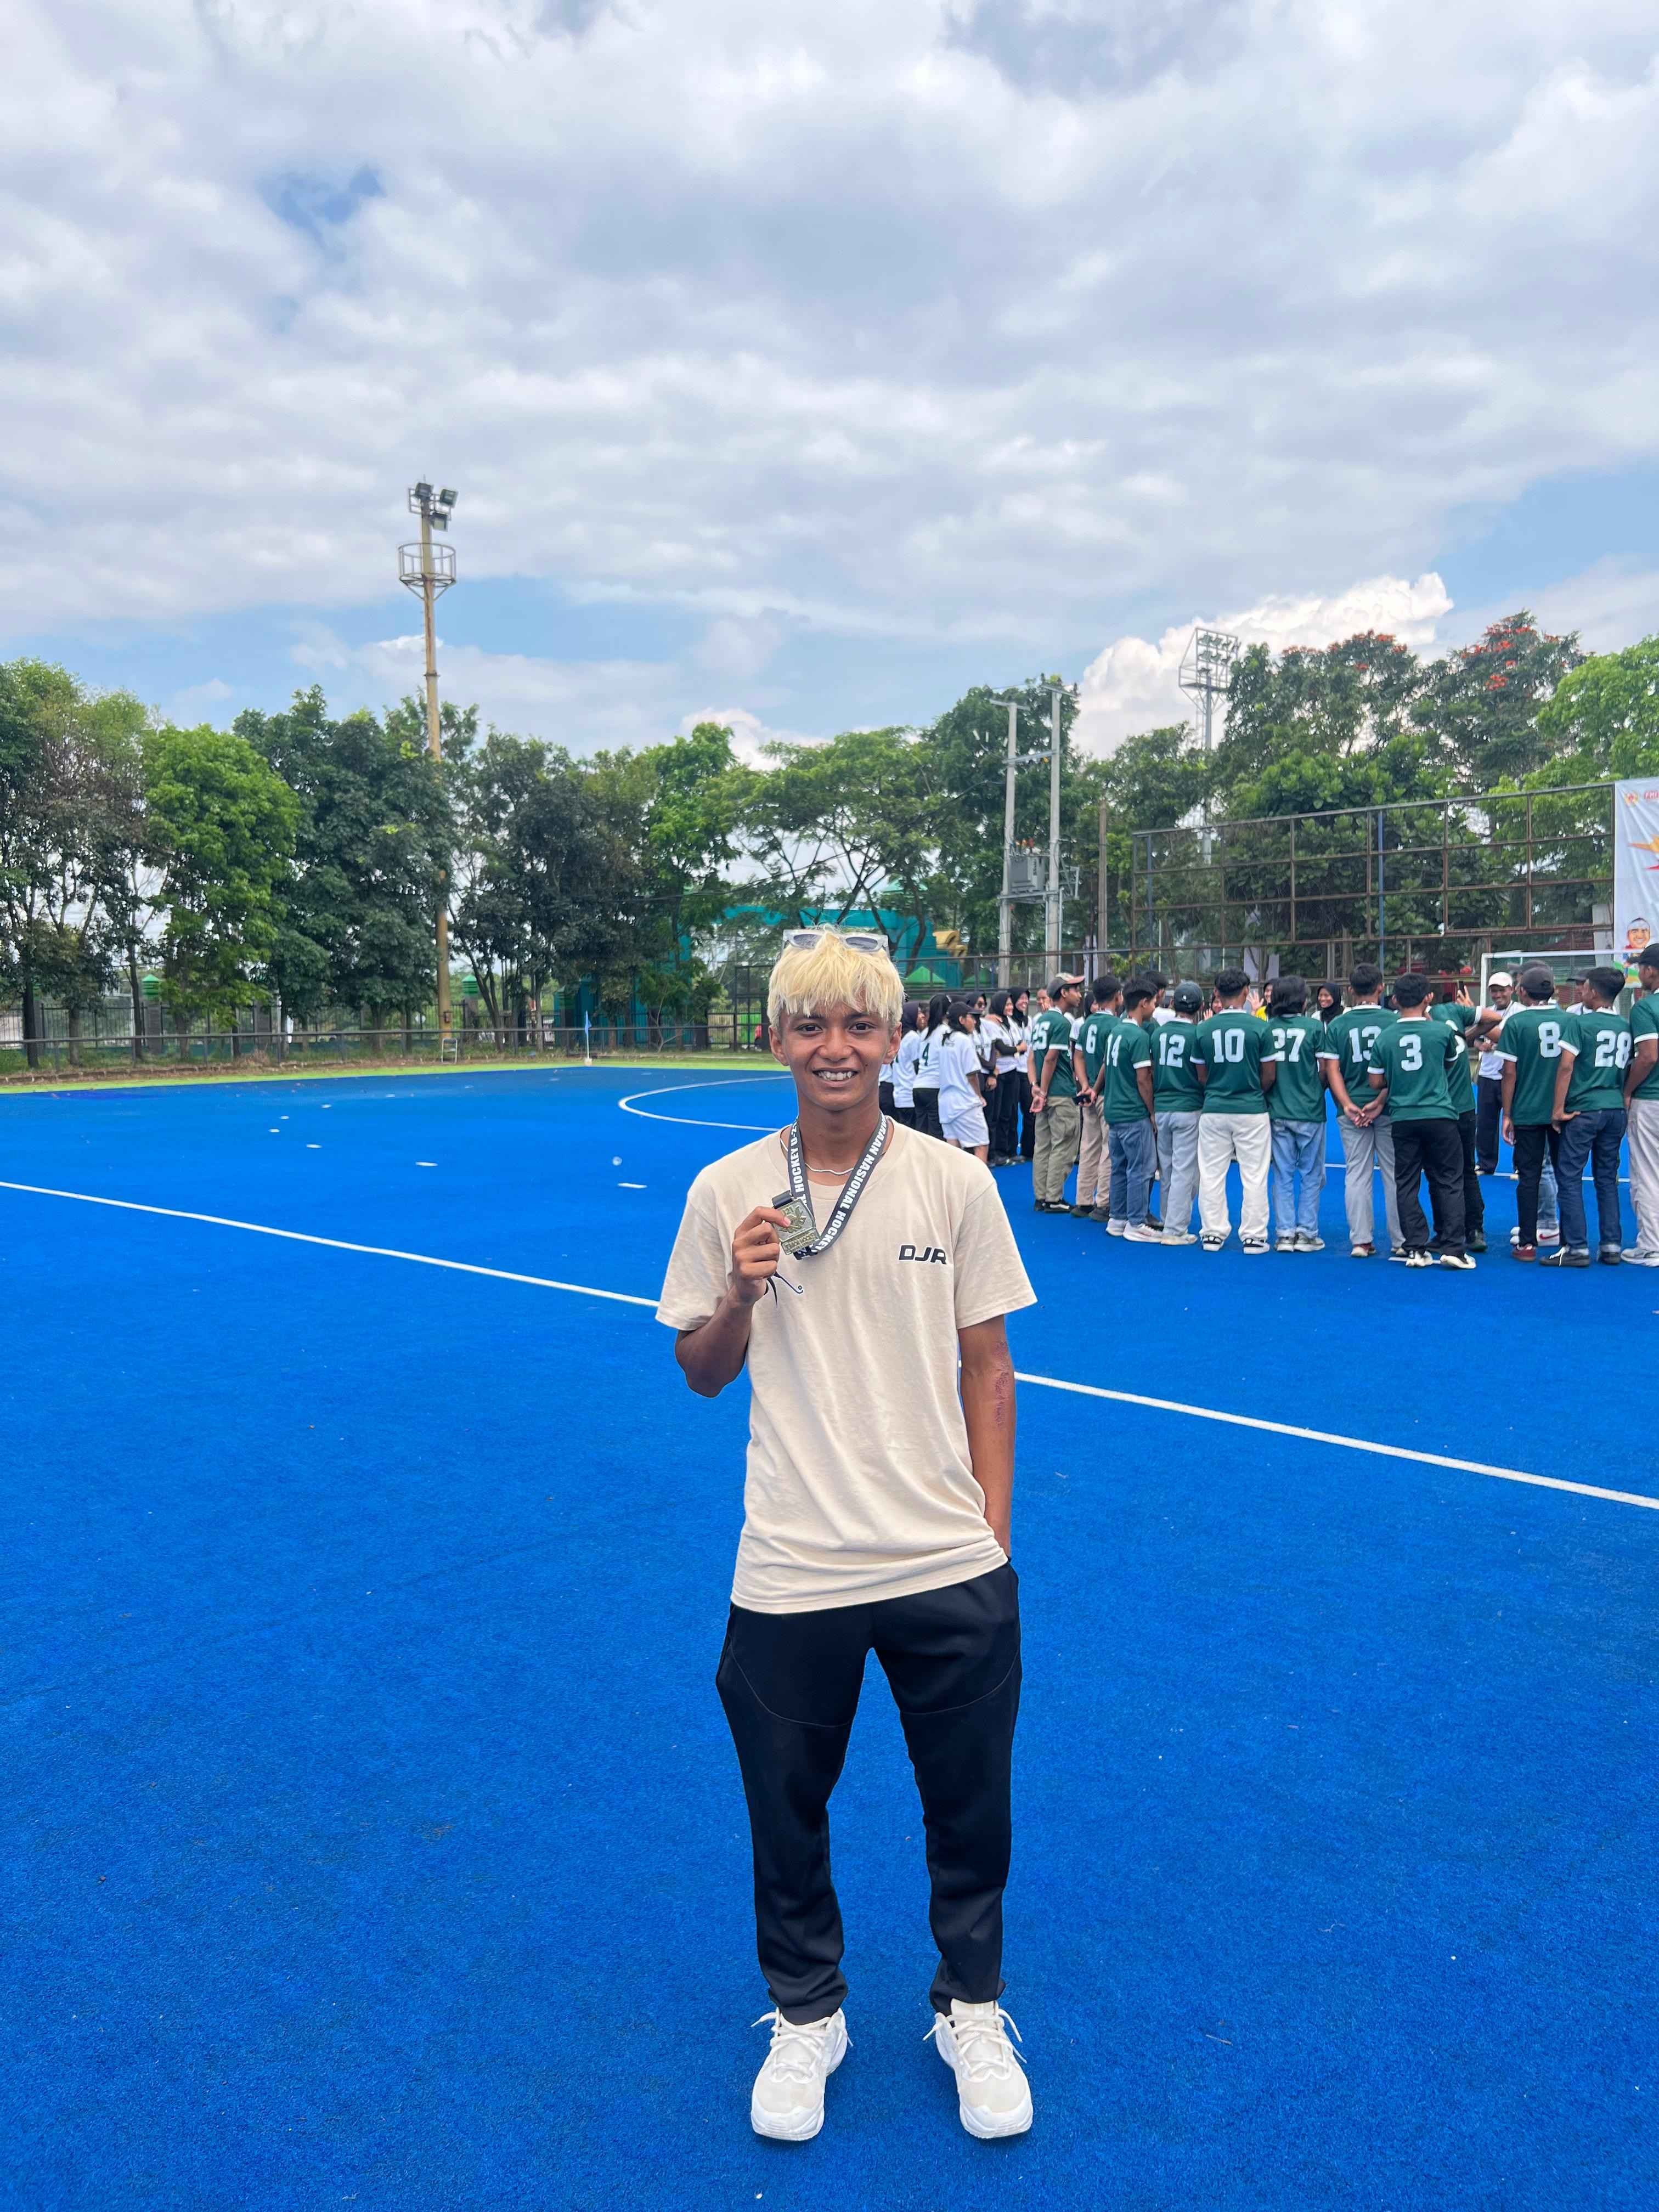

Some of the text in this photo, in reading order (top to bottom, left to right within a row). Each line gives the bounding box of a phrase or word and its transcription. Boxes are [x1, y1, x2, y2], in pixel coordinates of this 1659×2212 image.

[922, 1043, 929, 1066] 4
[1086, 1024, 1097, 1054] 6
[1106, 1034, 1122, 1067] 14
[1159, 1032, 1186, 1068] 12
[1212, 1028, 1245, 1063] 10
[1271, 1028, 1306, 1063] 27
[1349, 1025, 1381, 1063] 13
[1400, 1034, 1423, 1071] 3
[1538, 1021, 1562, 1058] 8
[1595, 1030, 1632, 1069] 28
[790, 1147, 805, 1193] HOCKEY
[839, 1154, 876, 1210] NASIONAL
[815, 1210, 847, 1251] HOCKEY
[898, 1244, 947, 1265] DJR
